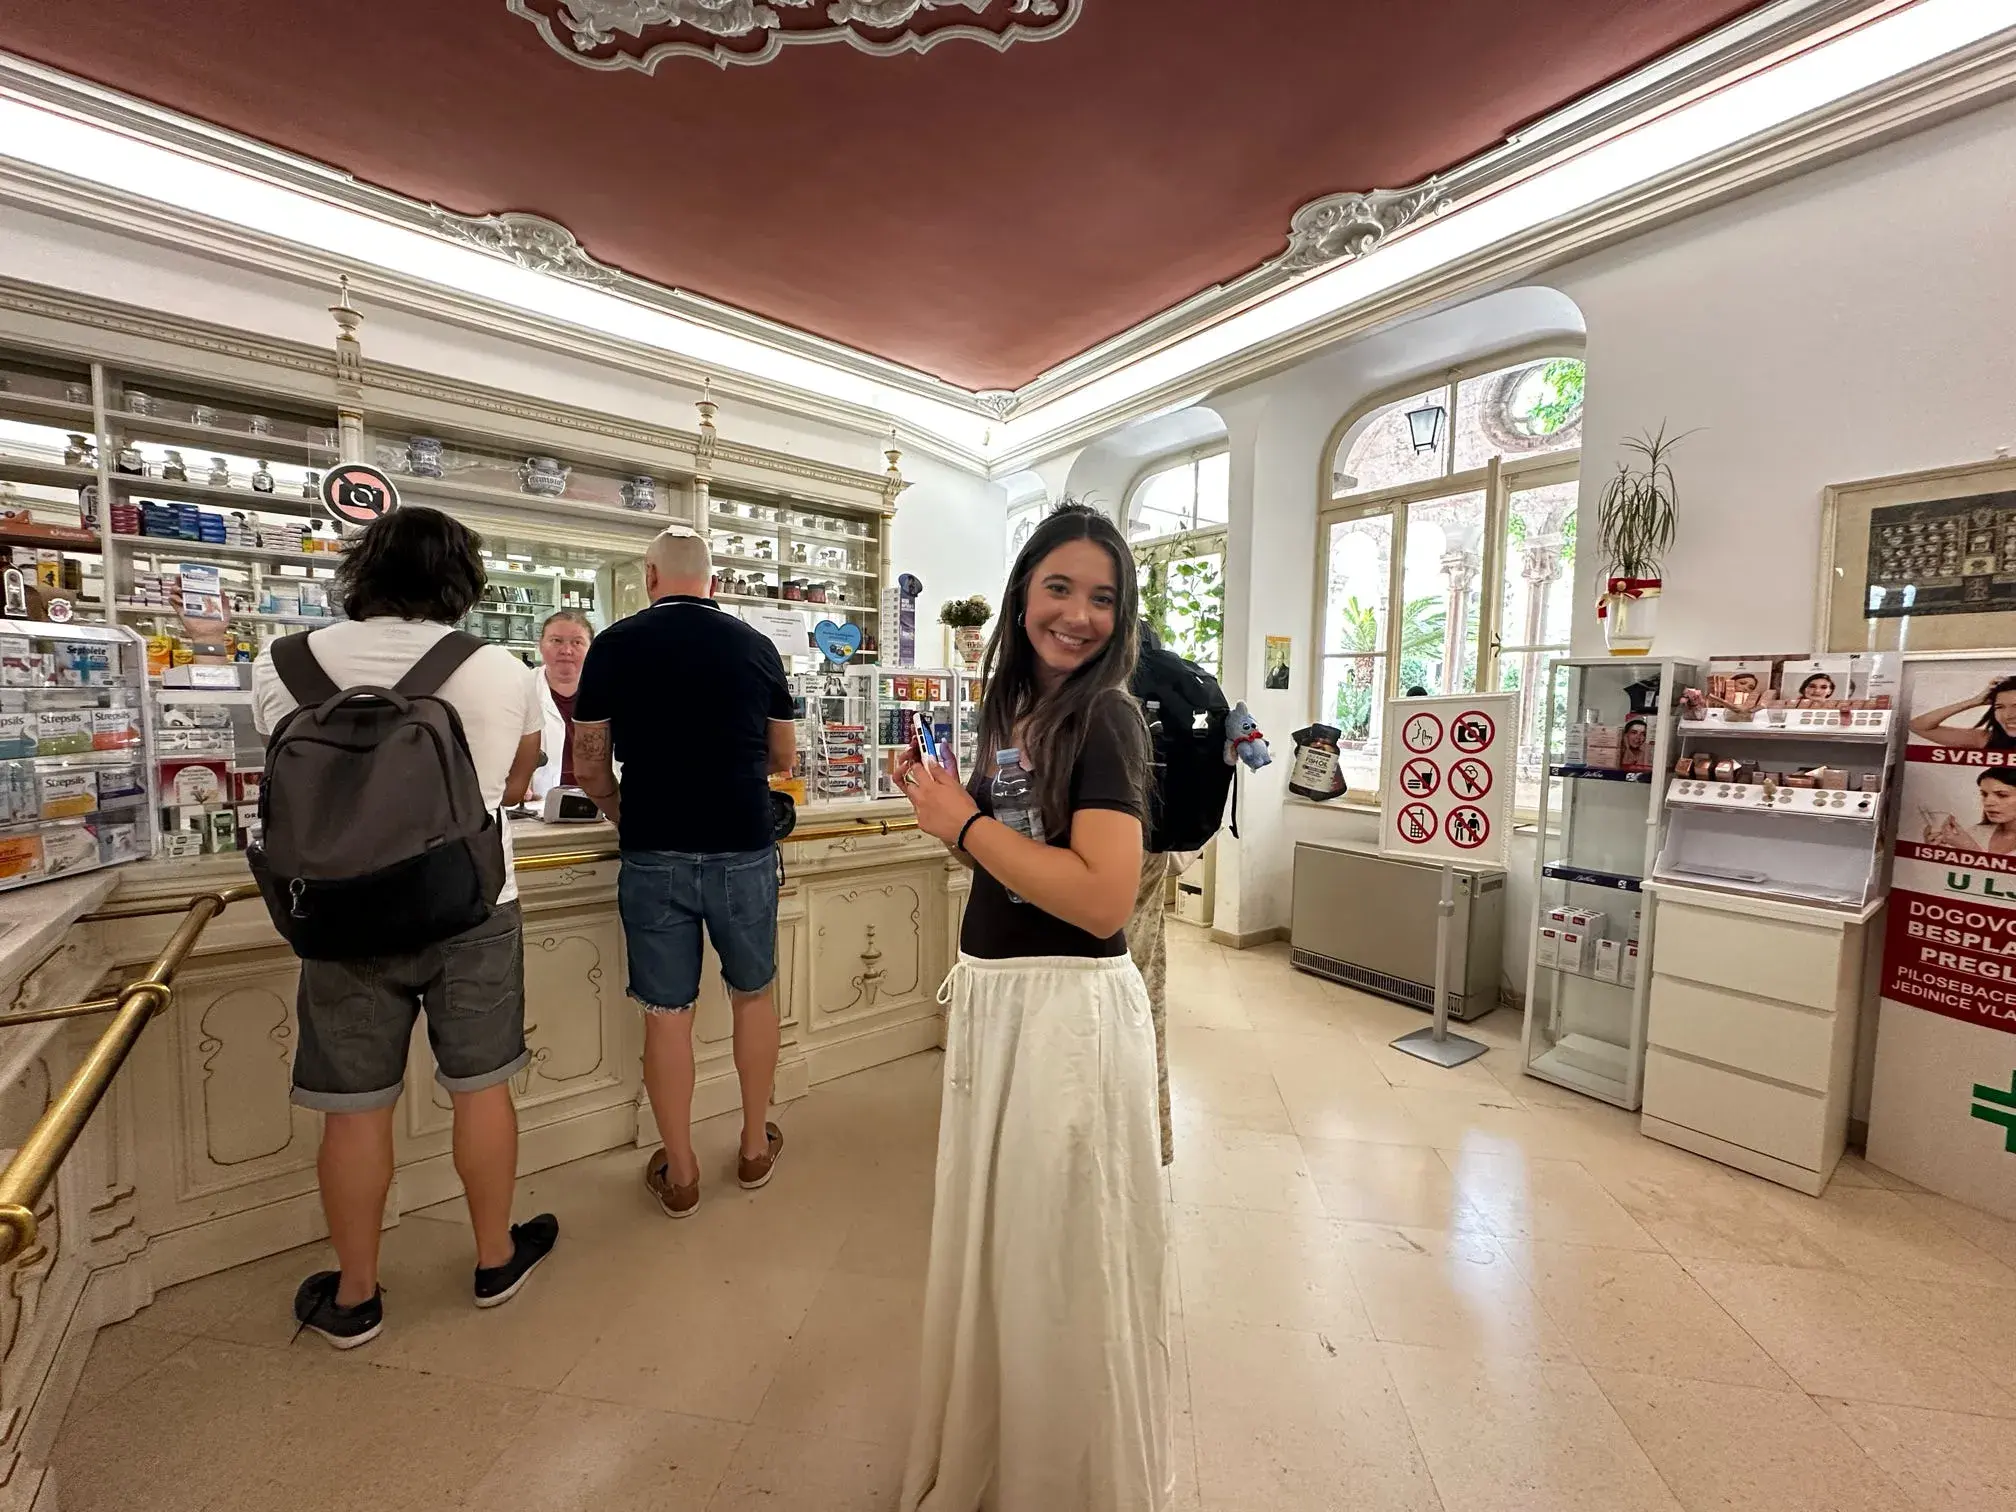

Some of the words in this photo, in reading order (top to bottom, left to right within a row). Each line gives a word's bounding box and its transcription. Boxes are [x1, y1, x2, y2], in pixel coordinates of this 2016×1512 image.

[40, 714, 81, 725] Strepsils
[1947, 872, 1971, 890] U
[1920, 947, 2016, 982] PREGL
[1891, 980, 1972, 1010] JEDINICE
[1977, 1002, 2016, 1022] VLA
[1898, 965, 2016, 1006] PILOSEBACE
